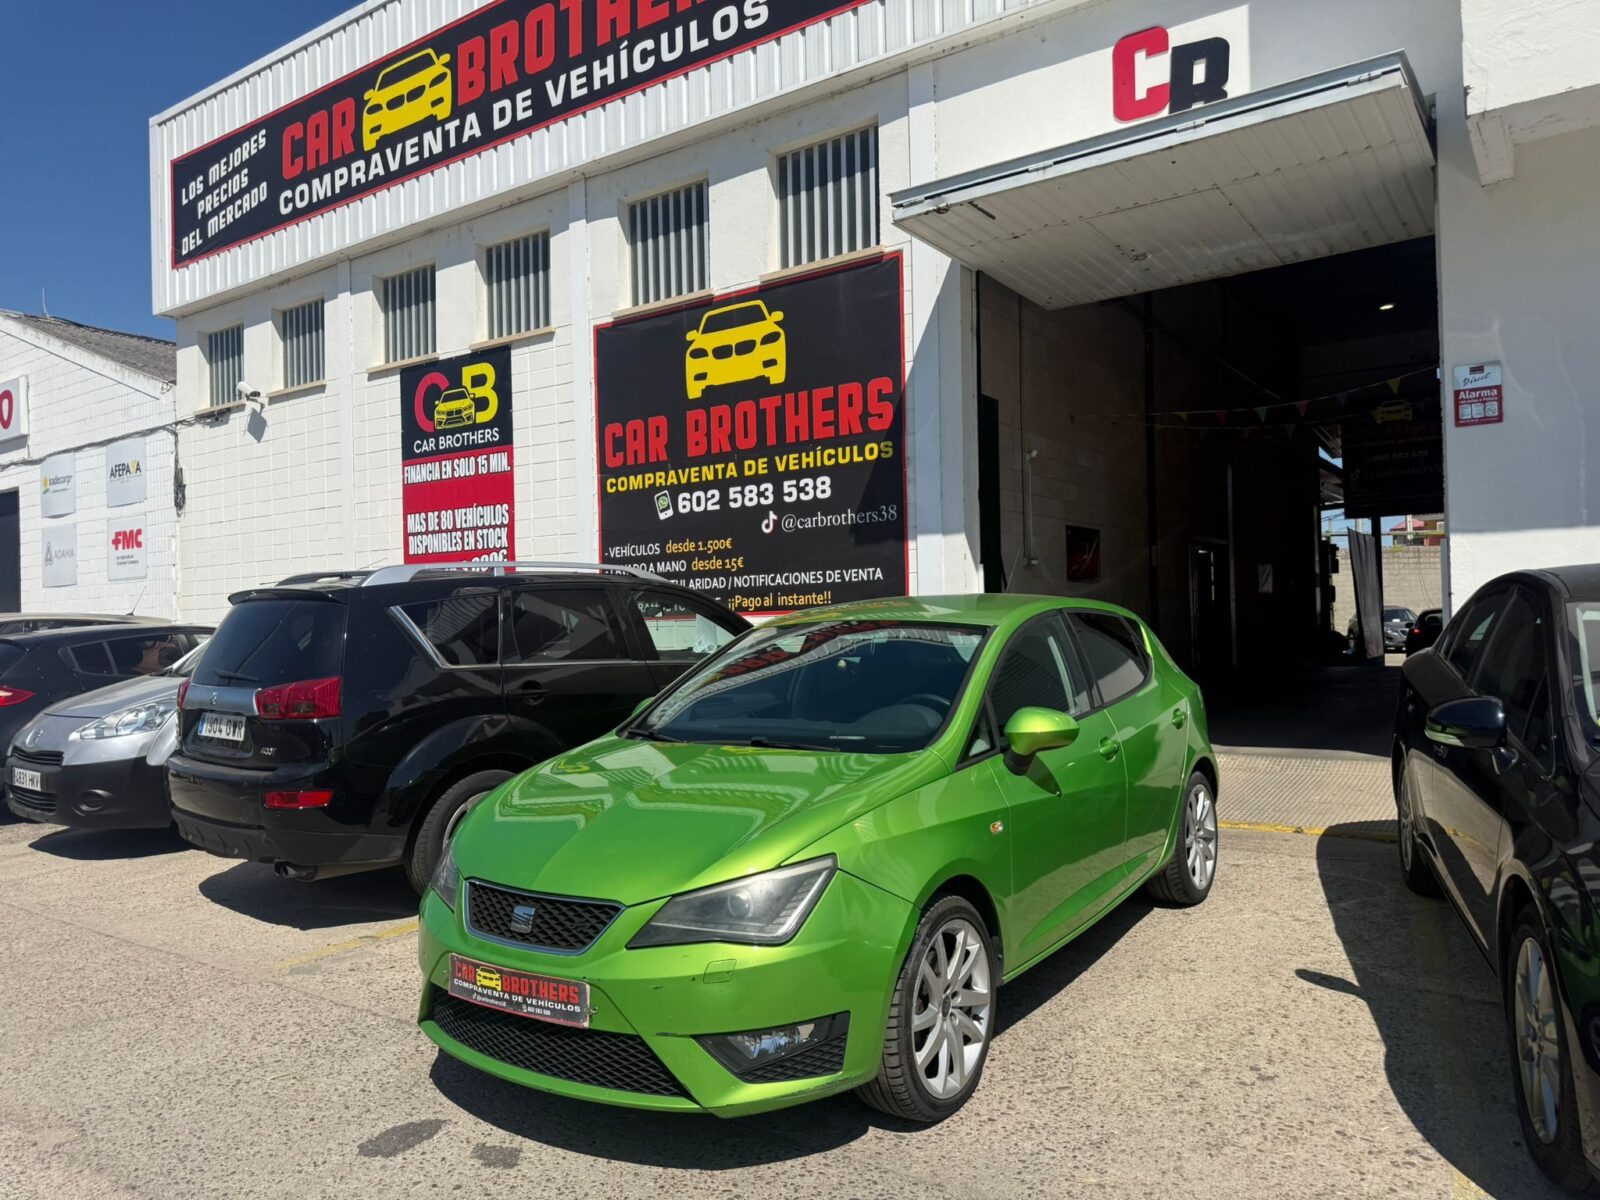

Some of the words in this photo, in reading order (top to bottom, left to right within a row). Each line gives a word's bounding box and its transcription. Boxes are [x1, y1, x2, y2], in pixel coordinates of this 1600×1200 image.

[282, 97, 356, 180] CAR
[457, 0, 705, 106] BROTH
[279, 111, 482, 215] COMPRAVENTA
[493, 88, 533, 130] DE
[545, 0, 769, 108] VEHÍCULOS
[182, 175, 204, 206] LOS
[208, 129, 267, 187] MEJORES
[197, 168, 249, 220] PRECIOS
[181, 228, 203, 256] DEL
[207, 181, 268, 239] MERCADO
[1458, 389, 1498, 400] Alarma
[604, 415, 668, 468] CAR
[686, 376, 894, 458] BROTHERS
[413, 438, 436, 454] CAR
[439, 427, 500, 450] BROTHERS
[404, 462, 440, 484] FINANCIA
[441, 460, 452, 479] EN
[454, 456, 475, 478] SOLO
[477, 455, 487, 474] 15
[489, 452, 511, 473] MIN.
[606, 462, 738, 494] COMPRAVENTA
[744, 457, 768, 476] DE
[775, 440, 893, 472] VEHÍCULOS
[677, 489, 720, 513] 602
[729, 482, 774, 508] 583
[783, 476, 832, 503] 538
[407, 512, 426, 533] MAS
[427, 511, 439, 531] DE
[441, 510, 453, 530] 80
[455, 503, 509, 528] VEHÍCULOS
[781, 504, 898, 533] @carbrothers38
[112, 528, 142, 550] FMC
[409, 531, 462, 555] DISPONIBLES
[464, 530, 475, 550] EN
[477, 527, 508, 549] STOCK
[665, 540, 696, 554] desde
[697, 538, 733, 554] 1.500€
[657, 560, 687, 573] MANO
[691, 556, 723, 571] desde
[724, 556, 744, 571] 15€
[734, 572, 823, 588] NOTIFICACIONES
[826, 571, 840, 584] DE
[841, 567, 883, 582] VENTA
[763, 593, 773, 607] al
[777, 591, 832, 607] instante!!
[205, 714, 223, 735] 1904
[226, 717, 243, 738] GWR
[453, 978, 510, 1000] COMPRAVENTA
[512, 994, 523, 1003] DE
[526, 997, 581, 1013] VEHÍCULOS
[455, 960, 475, 982] CAR
[502, 975, 579, 1004] BROTHERS
